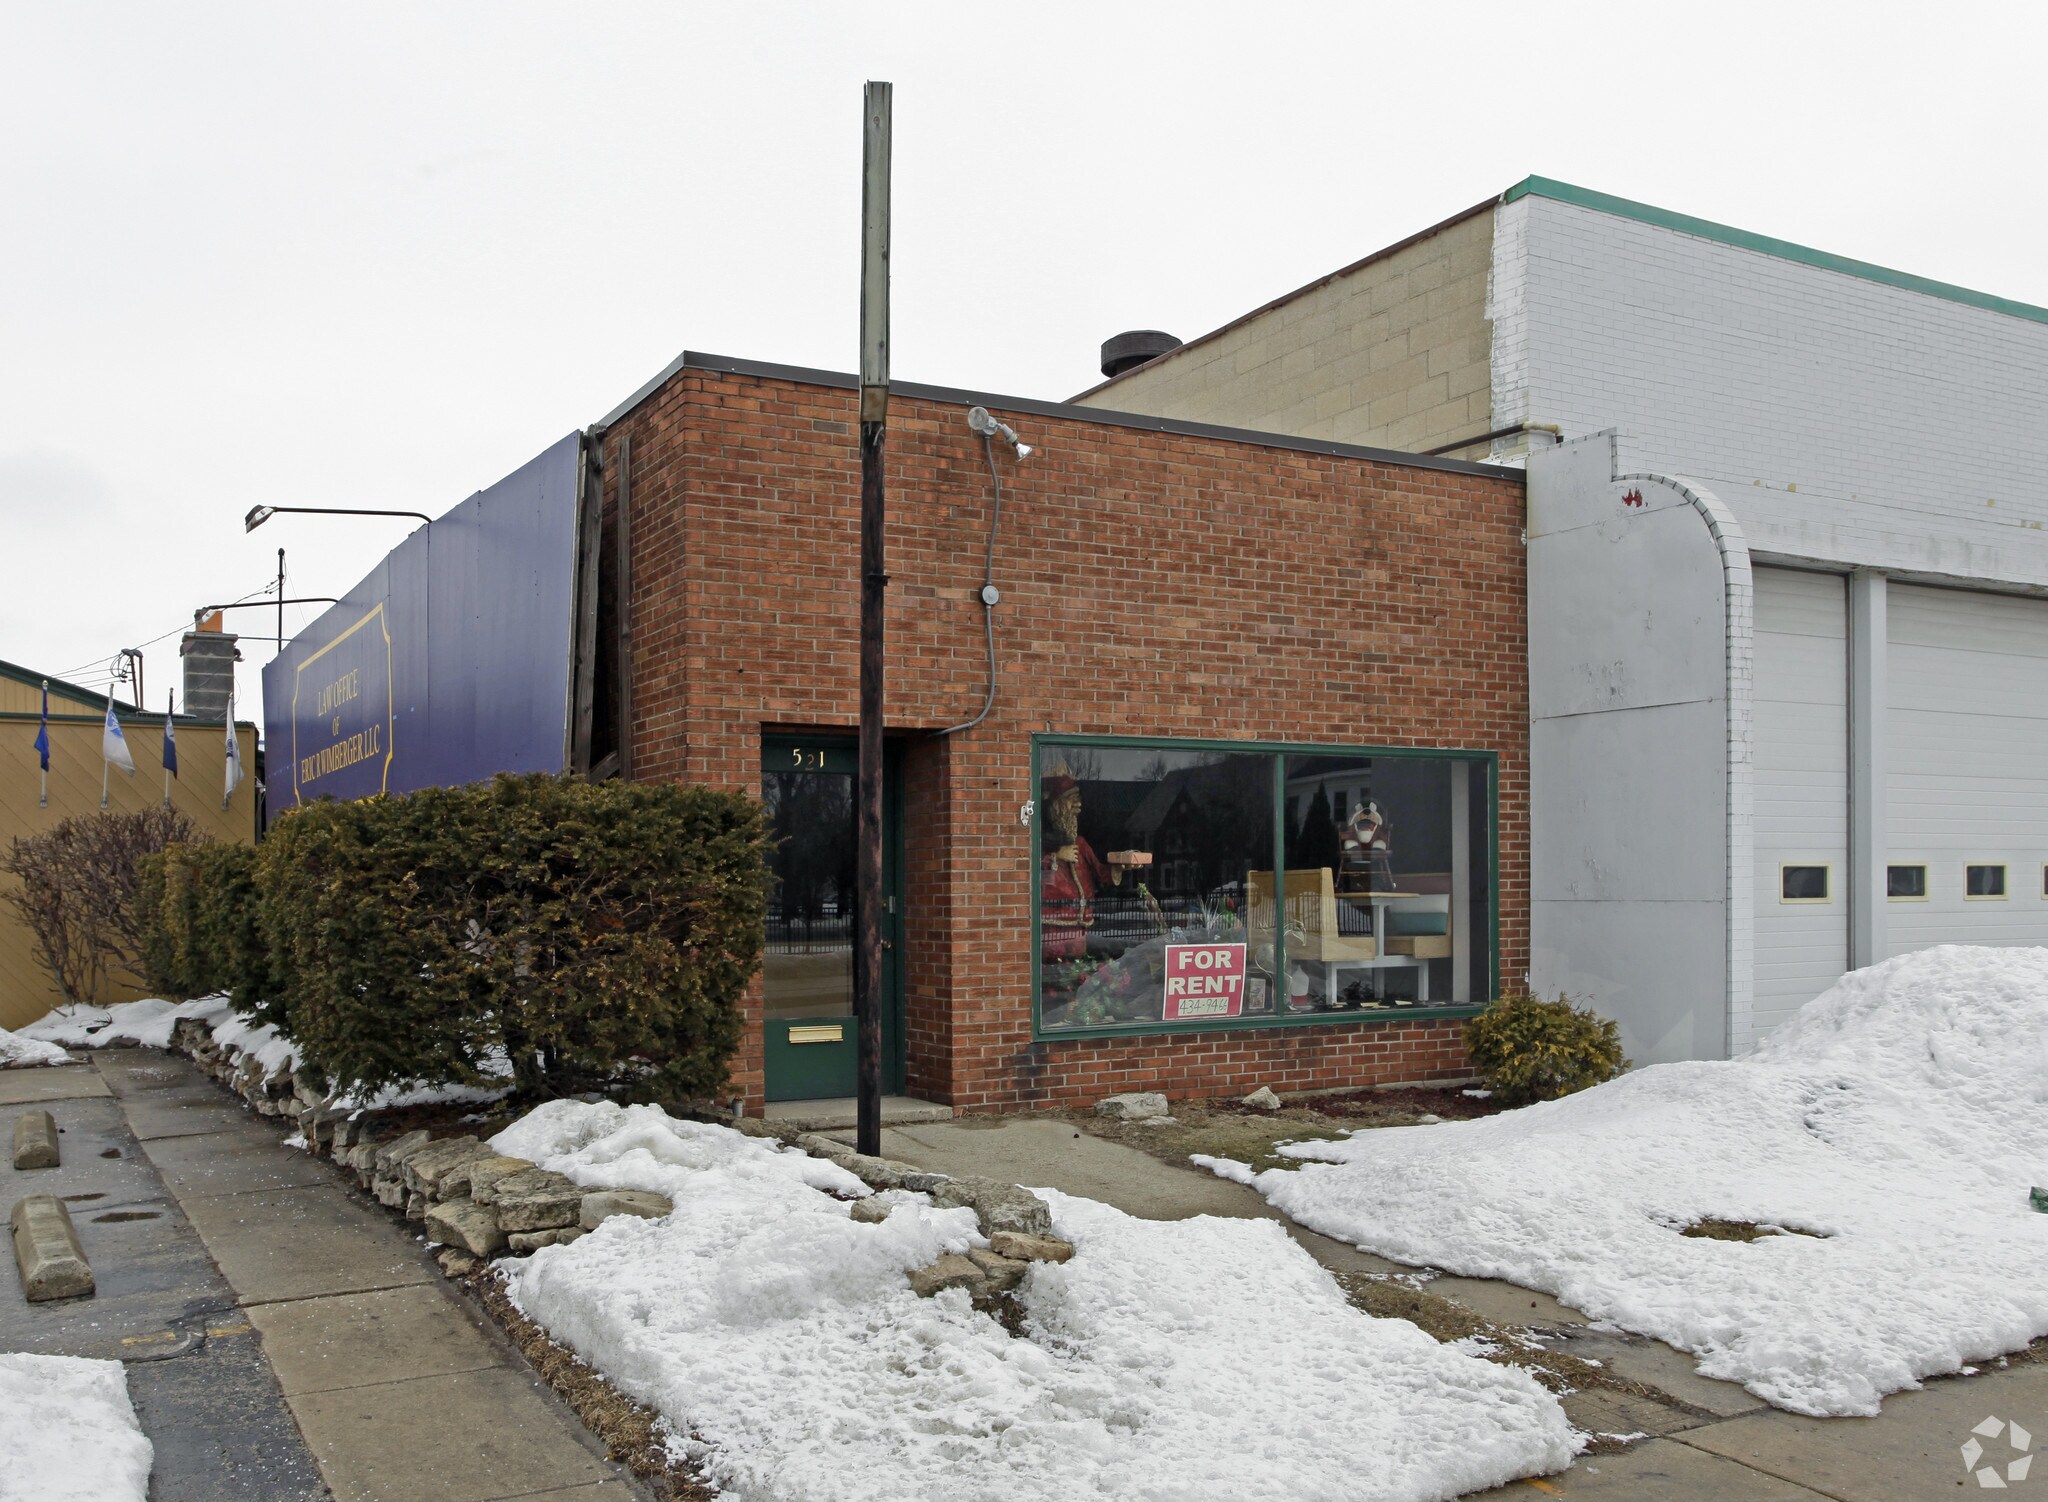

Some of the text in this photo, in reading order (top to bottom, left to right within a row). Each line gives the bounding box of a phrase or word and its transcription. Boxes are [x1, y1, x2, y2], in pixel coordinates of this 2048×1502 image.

[318, 668, 358, 716] LAW OFFICE
[332, 716, 339, 736] OF
[301, 754, 316, 784] ERIC
[321, 733, 363, 774] WIMBERGER
[364, 724, 380, 759] LLC
[793, 748, 824, 771] 521
[1179, 950, 1232, 969] FOR
[1168, 975, 1242, 996] RENT
